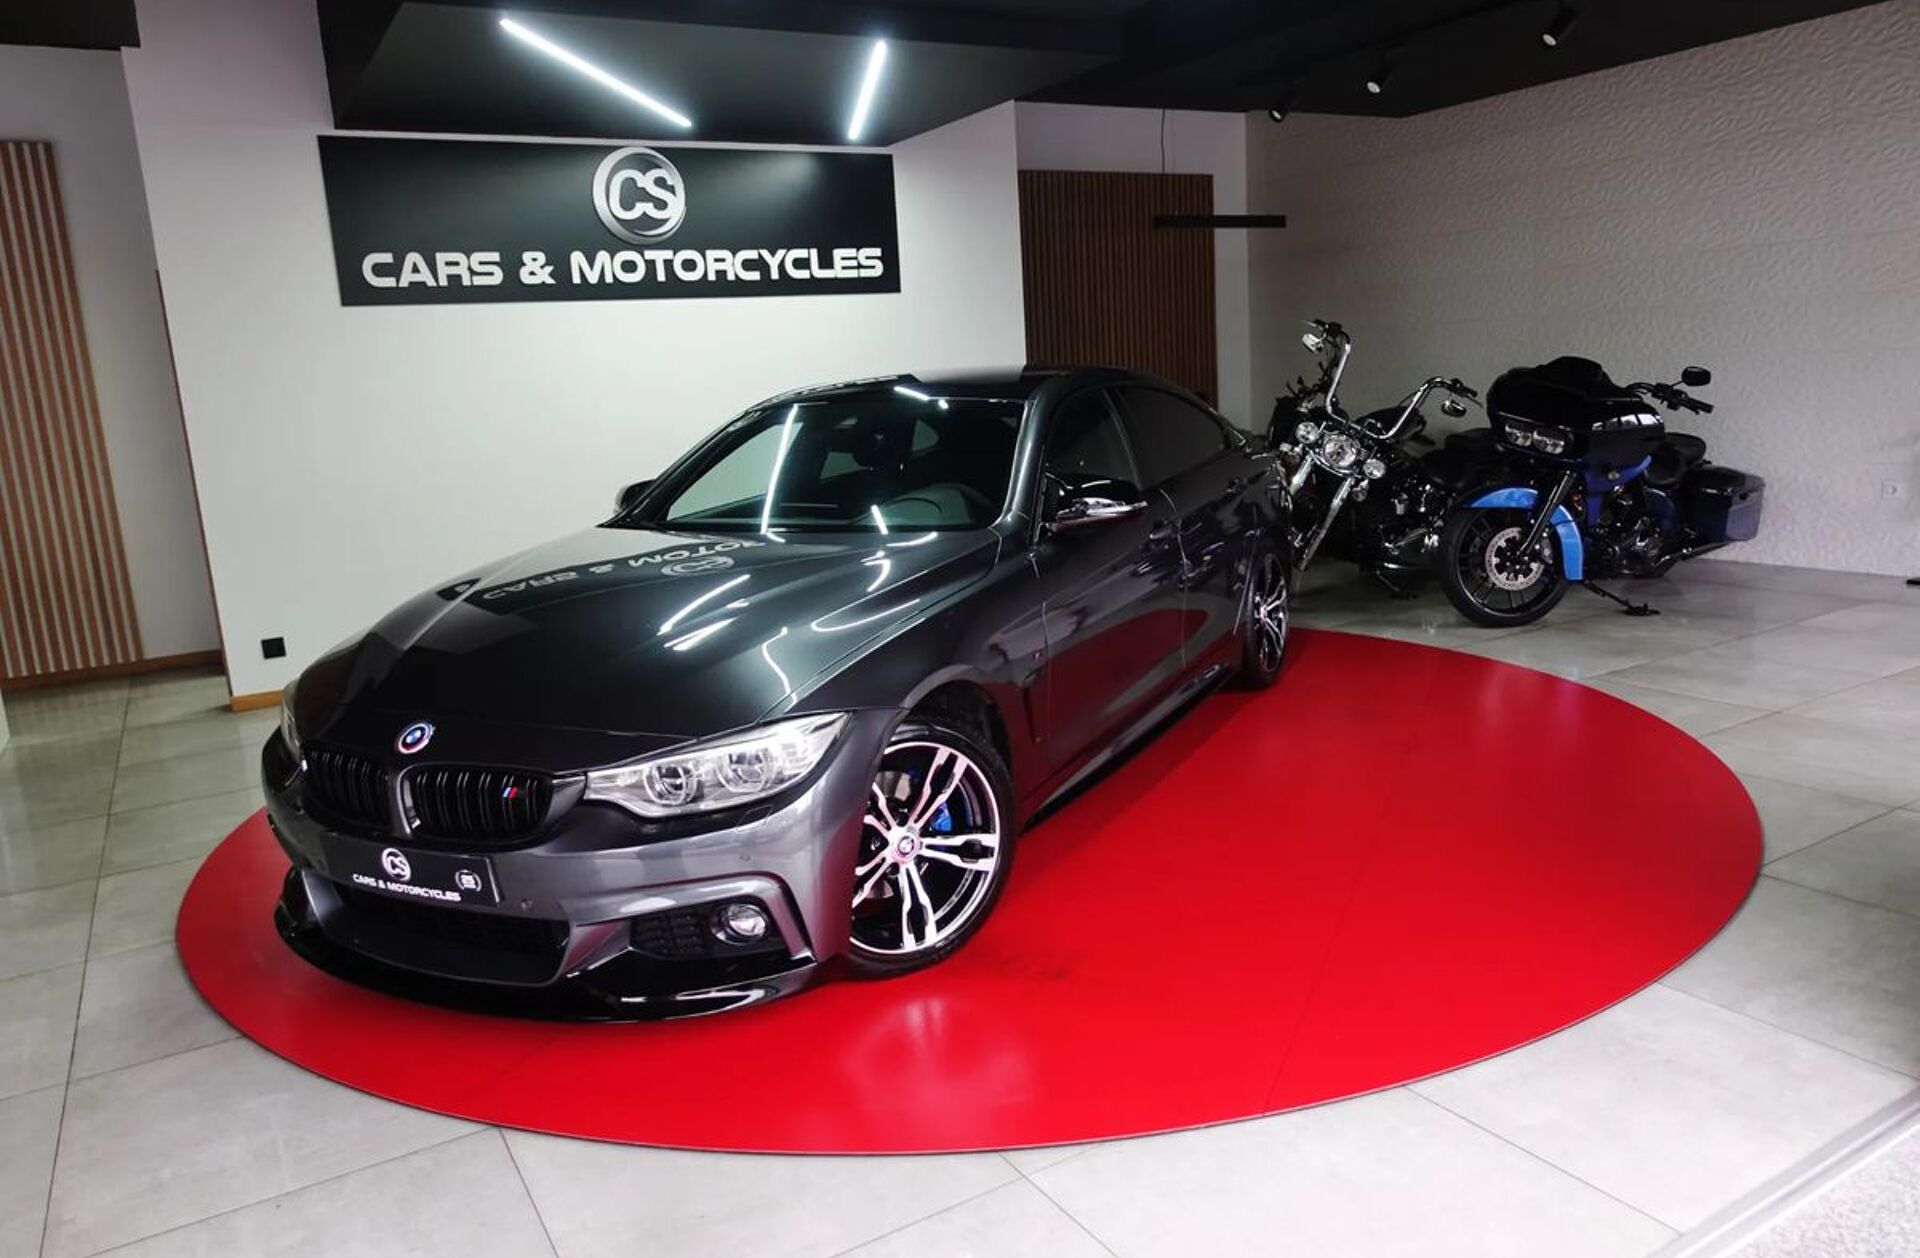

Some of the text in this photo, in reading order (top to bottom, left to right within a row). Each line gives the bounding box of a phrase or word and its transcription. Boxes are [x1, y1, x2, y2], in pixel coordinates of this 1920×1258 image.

[609, 168, 679, 220] CS
[362, 247, 883, 288] CARS & MOTORCYCLES
[353, 874, 461, 902] CARS & MOTORCYCLES
